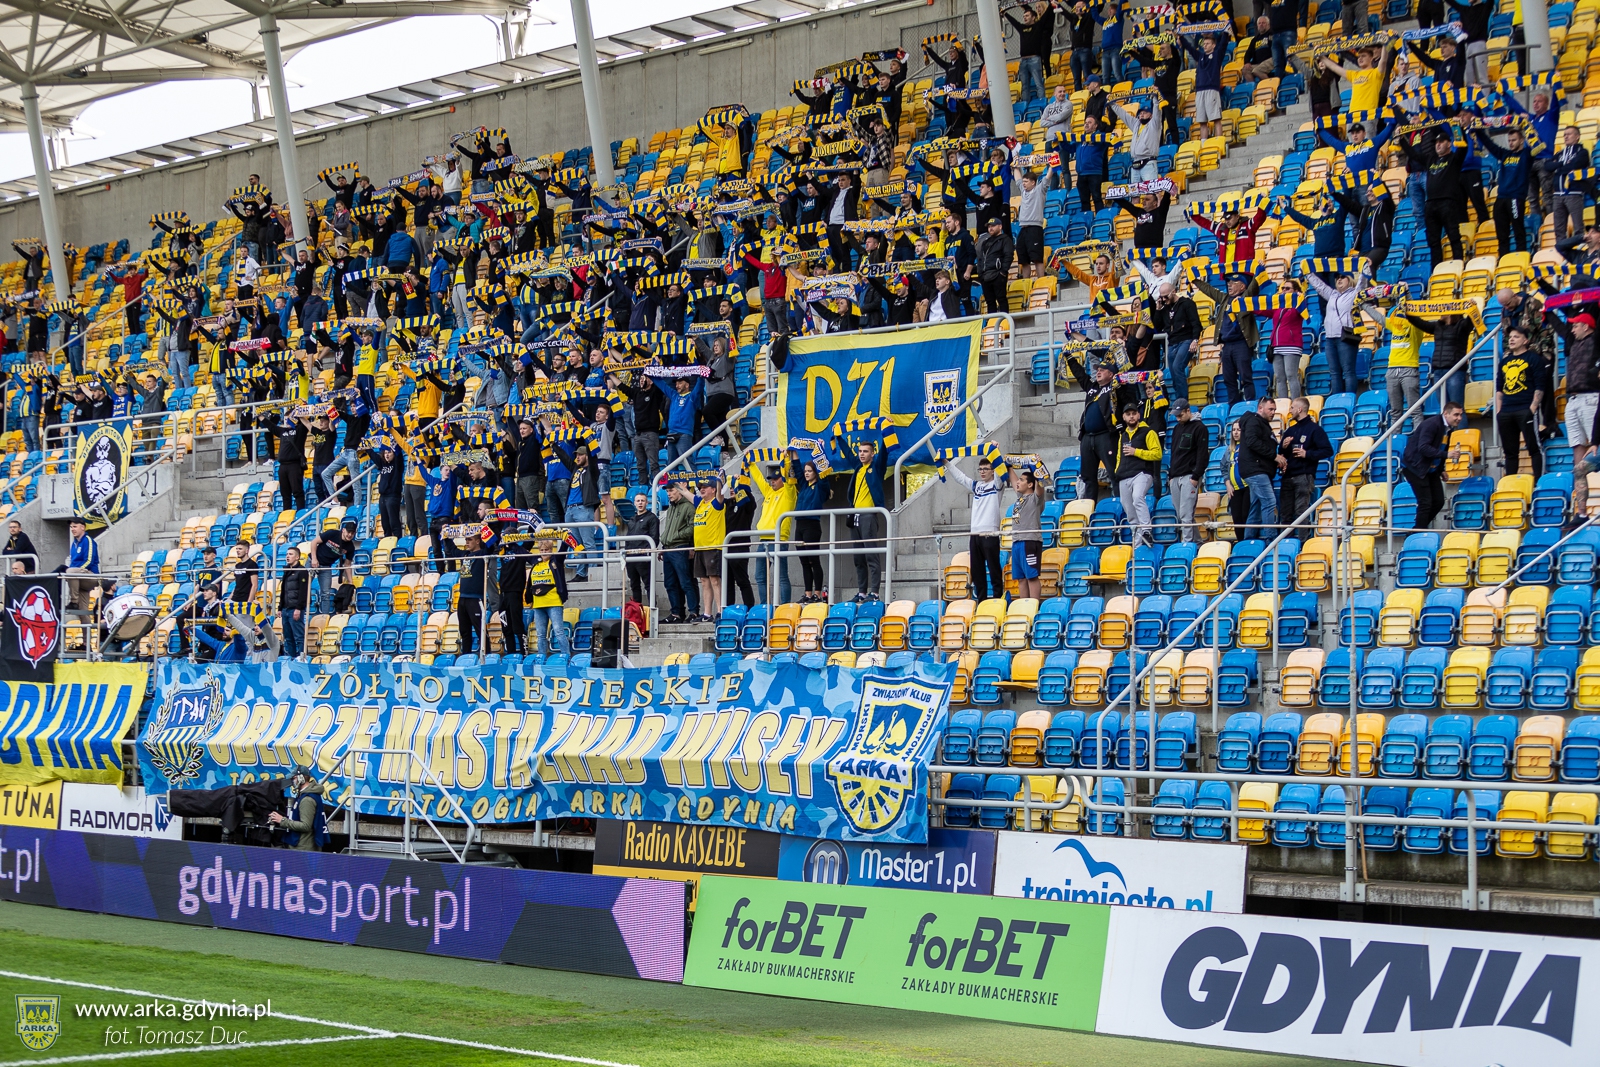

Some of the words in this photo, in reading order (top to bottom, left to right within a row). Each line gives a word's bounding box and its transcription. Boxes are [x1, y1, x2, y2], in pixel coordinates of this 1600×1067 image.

[929, 403, 954, 414] ARKA
[311, 666, 744, 708] ŻÓŁTO-NIEBIESKIE
[910, 687, 932, 703] KLUB
[851, 703, 871, 751] MORSKI
[901, 707, 935, 763] SPORTOWY
[208, 703, 380, 780] OBLICZE
[378, 706, 544, 789] MIASTA
[537, 712, 667, 785] ZNAD
[661, 708, 847, 798] WISŁY
[839, 757, 902, 783] ARKA
[69, 809, 153, 832] RADMOR
[387, 790, 538, 820] PATOLOGIA
[570, 790, 643, 817] ARKA
[677, 795, 798, 831] GDYNIA
[624, 821, 671, 863] Radio
[178, 855, 472, 945] gdyniasport.pl
[721, 897, 867, 960] forBET
[905, 912, 1071, 980] forBET
[717, 958, 765, 975] ZAKŁADY
[766, 962, 856, 984] BUKMACHERSKIE
[901, 977, 956, 995] ZAKŁADY
[957, 983, 1059, 1006] BUKMACHERSKIE
[1160, 926, 1582, 1047] GDYNIA
